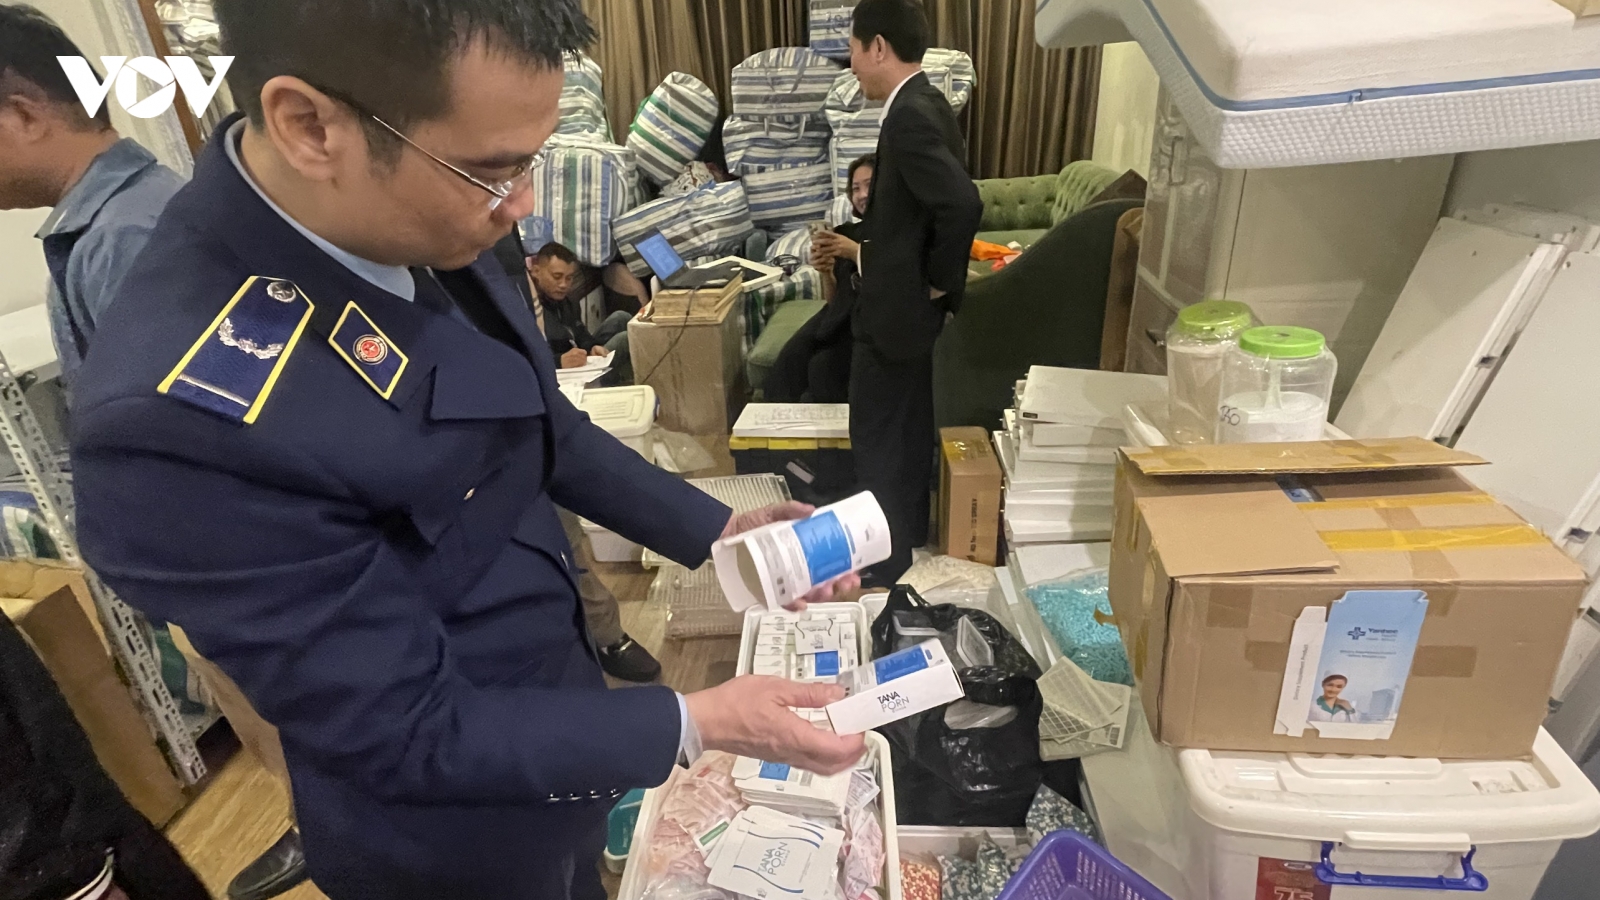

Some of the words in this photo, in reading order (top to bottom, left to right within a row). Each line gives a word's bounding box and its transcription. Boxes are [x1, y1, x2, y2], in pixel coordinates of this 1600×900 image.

[877, 691, 901, 705] TANA
[881, 696, 910, 713] PORN
[757, 848, 776, 872] TANA
[767, 841, 788, 876] PORN
